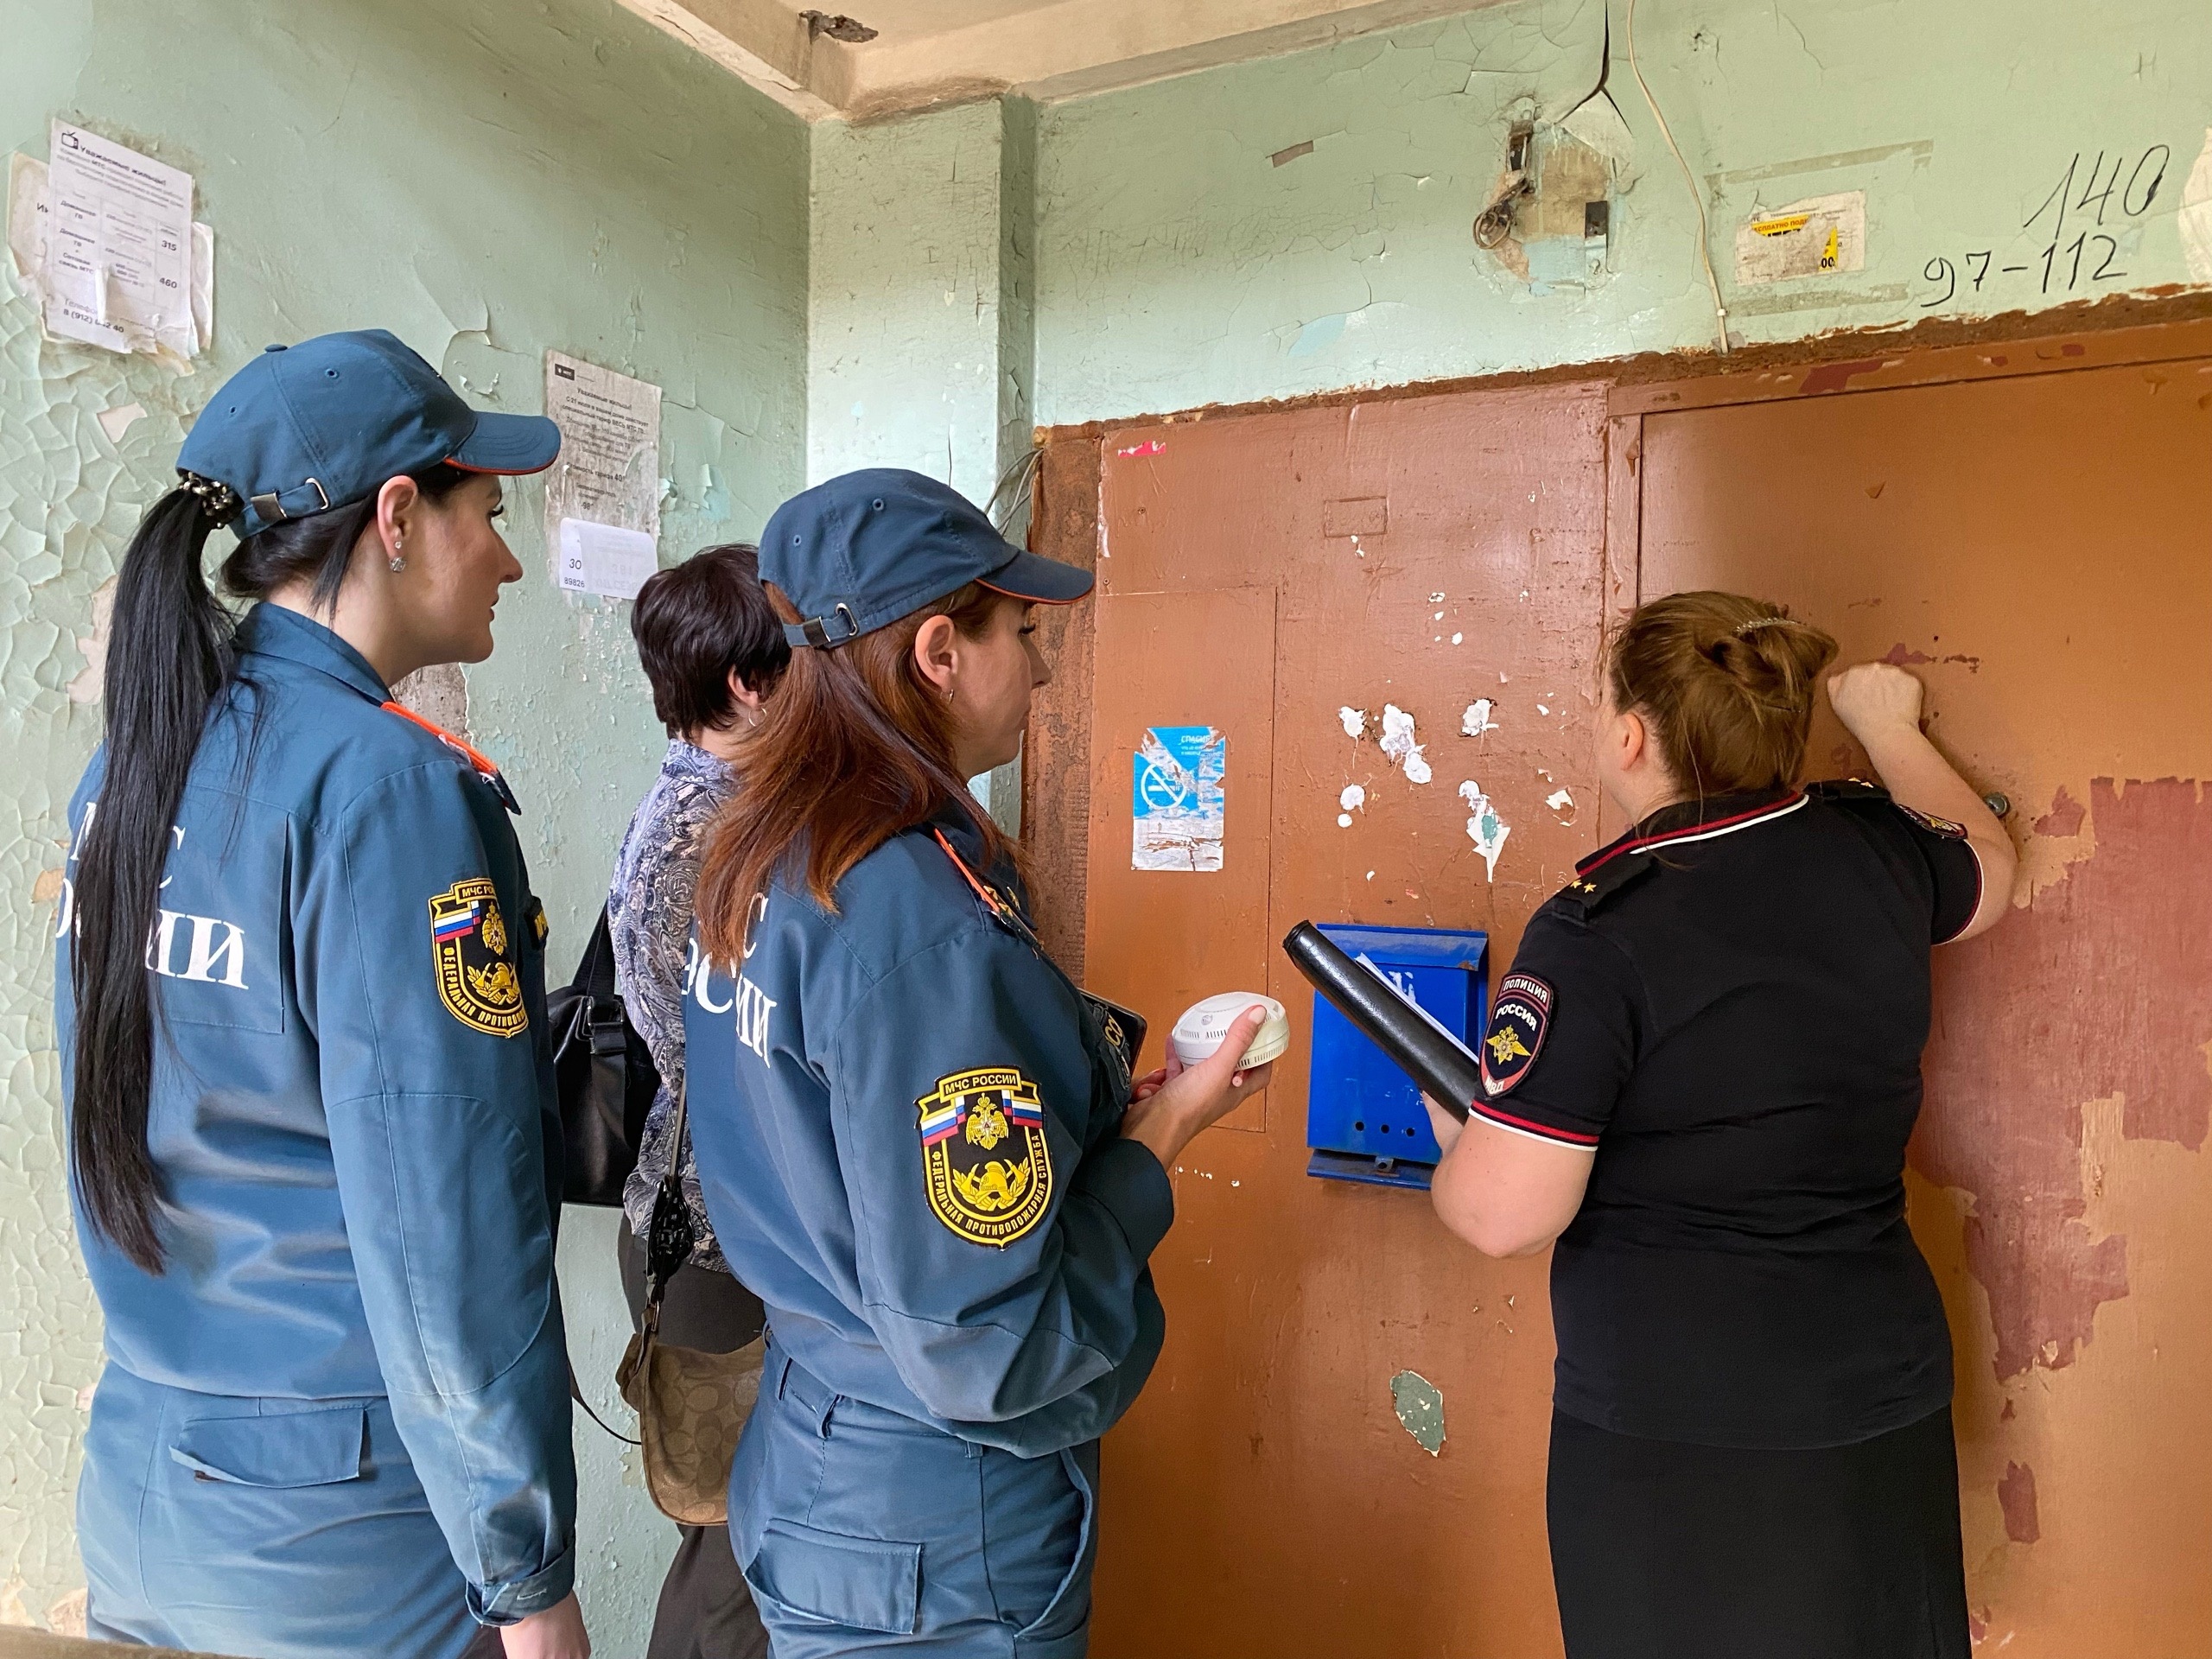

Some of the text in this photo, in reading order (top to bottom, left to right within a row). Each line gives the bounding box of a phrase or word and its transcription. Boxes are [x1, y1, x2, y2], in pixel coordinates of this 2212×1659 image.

[2024, 145, 2170, 239] 140
[162, 240, 177, 251] 315
[159, 277, 178, 289] 460
[71, 311, 92, 324] (912)
[569, 558, 582, 570] 30
[461, 886, 483, 898] МЧС
[443, 947, 477, 1015] ФЕДЕРАЛЬНАЯ
[1503, 978, 1548, 1003] ПОЛИЦИЯ
[1495, 1003, 1538, 1032] РОССИЯ
[944, 1072, 1016, 1095] МЧС РОССИИ
[1484, 1074, 1504, 1095] МВД
[931, 1135, 1047, 1236] ФЕДЕРАЛЬНАЯ ПРОТИВОПОЖАРНАЯ СЛУЖБА
